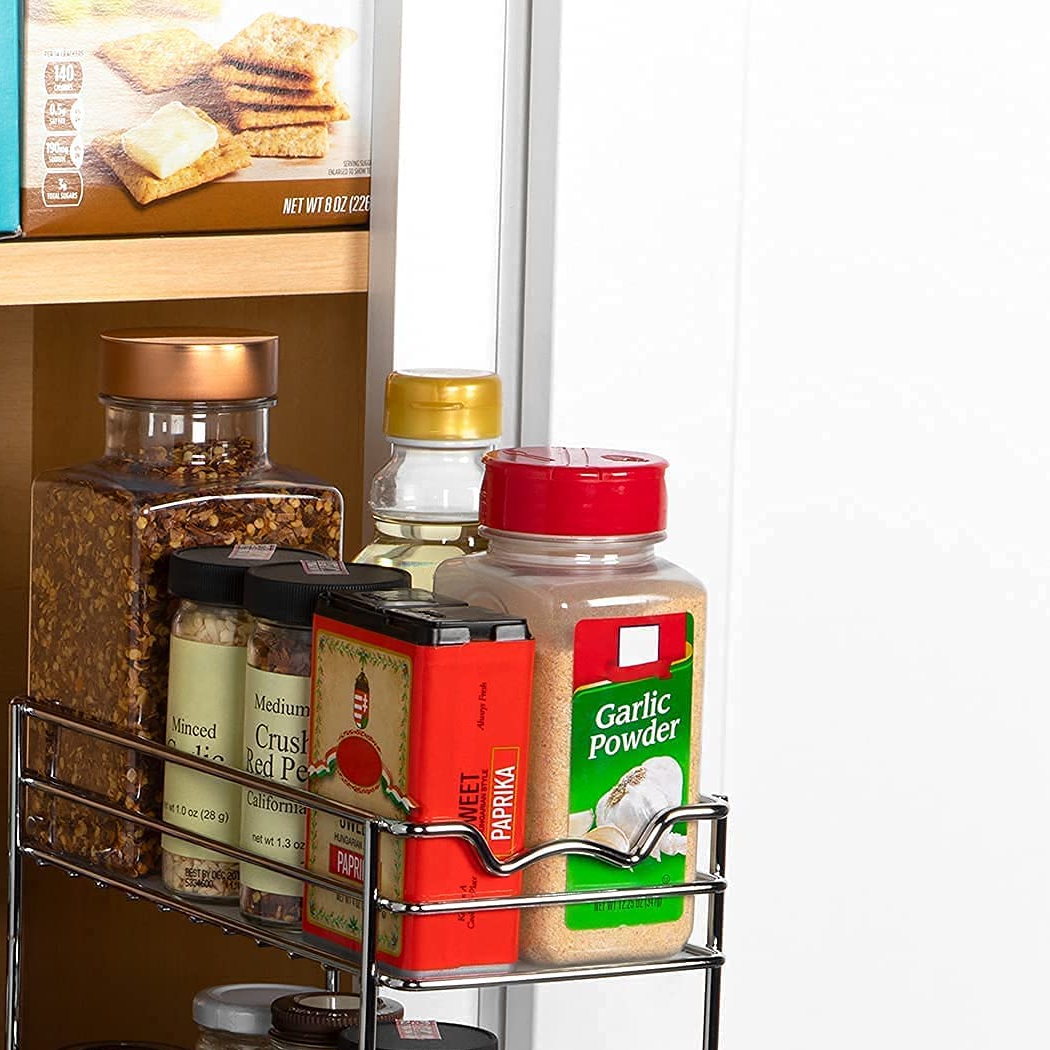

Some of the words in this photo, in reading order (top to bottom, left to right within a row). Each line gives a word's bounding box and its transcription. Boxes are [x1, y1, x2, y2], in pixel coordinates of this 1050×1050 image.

[283, 198, 304, 214] NET
[306, 197, 324, 213] WT
[325, 196, 332, 212] 8
[333, 196, 347, 212] OZ
[254, 693, 310, 718] Medium
[595, 690, 671, 730] Garlic
[171, 715, 217, 739] Minced
[587, 717, 681, 760] Powder
[246, 747, 274, 778] Red
[247, 790, 307, 814] California
[458, 772, 480, 824] WEET
[491, 766, 516, 840] PAPRIKA
[176, 804, 187, 816] 1.0
[188, 809, 198, 819] oz
[200, 808, 216, 821] (28
[218, 811, 230, 823] g)
[264, 836, 274, 847] wt
[276, 837, 291, 849] 1.3
[294, 841, 306, 850] oz
